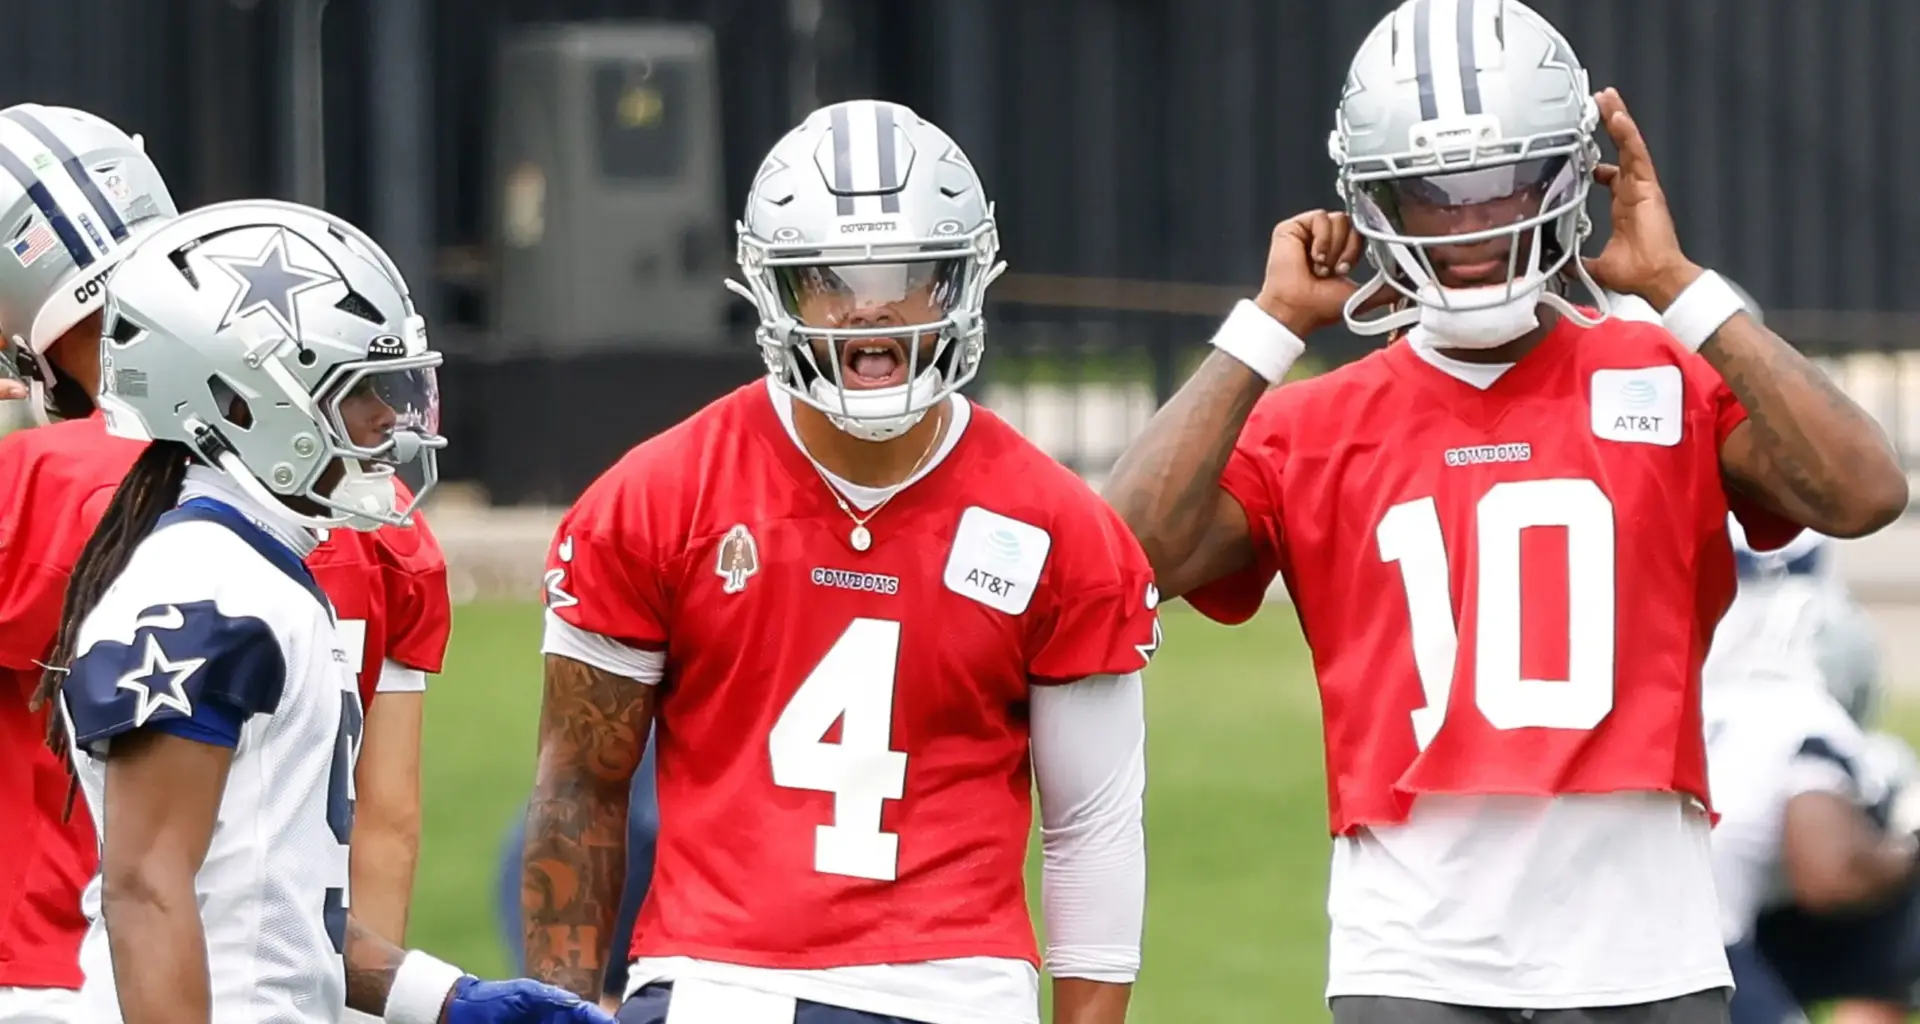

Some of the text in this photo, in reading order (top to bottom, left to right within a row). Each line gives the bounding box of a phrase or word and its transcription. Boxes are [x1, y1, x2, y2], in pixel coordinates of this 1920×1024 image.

[369, 346, 404, 354] OAKLEY
[1614, 415, 1663, 433] AT&T
[1445, 443, 1531, 467] COWBOYS
[812, 567, 899, 595] COWBOYS
[965, 568, 1016, 598] AT&T
[1376, 478, 1616, 753] 10
[768, 617, 908, 882] 4
